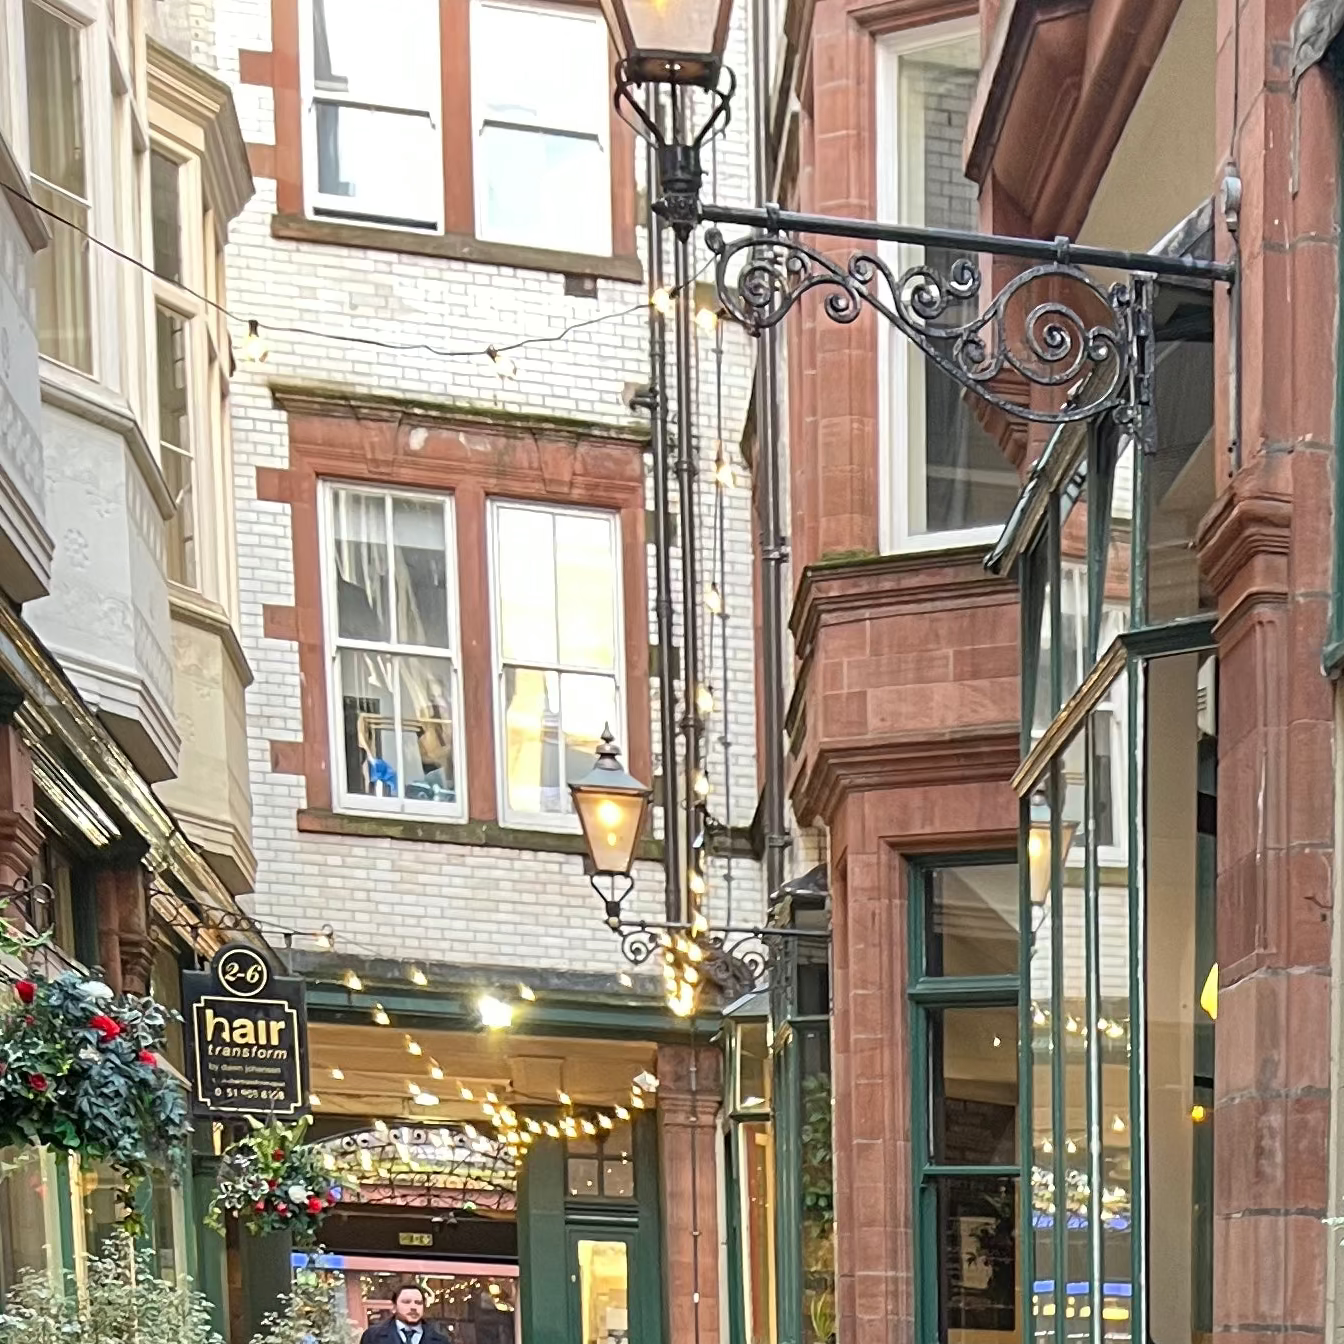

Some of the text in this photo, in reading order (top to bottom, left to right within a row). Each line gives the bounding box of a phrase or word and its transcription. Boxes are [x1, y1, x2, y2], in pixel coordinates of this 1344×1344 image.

[225, 962, 262, 984] 2-6
[205, 1008, 286, 1046] hair
[207, 1043, 288, 1060] transform
